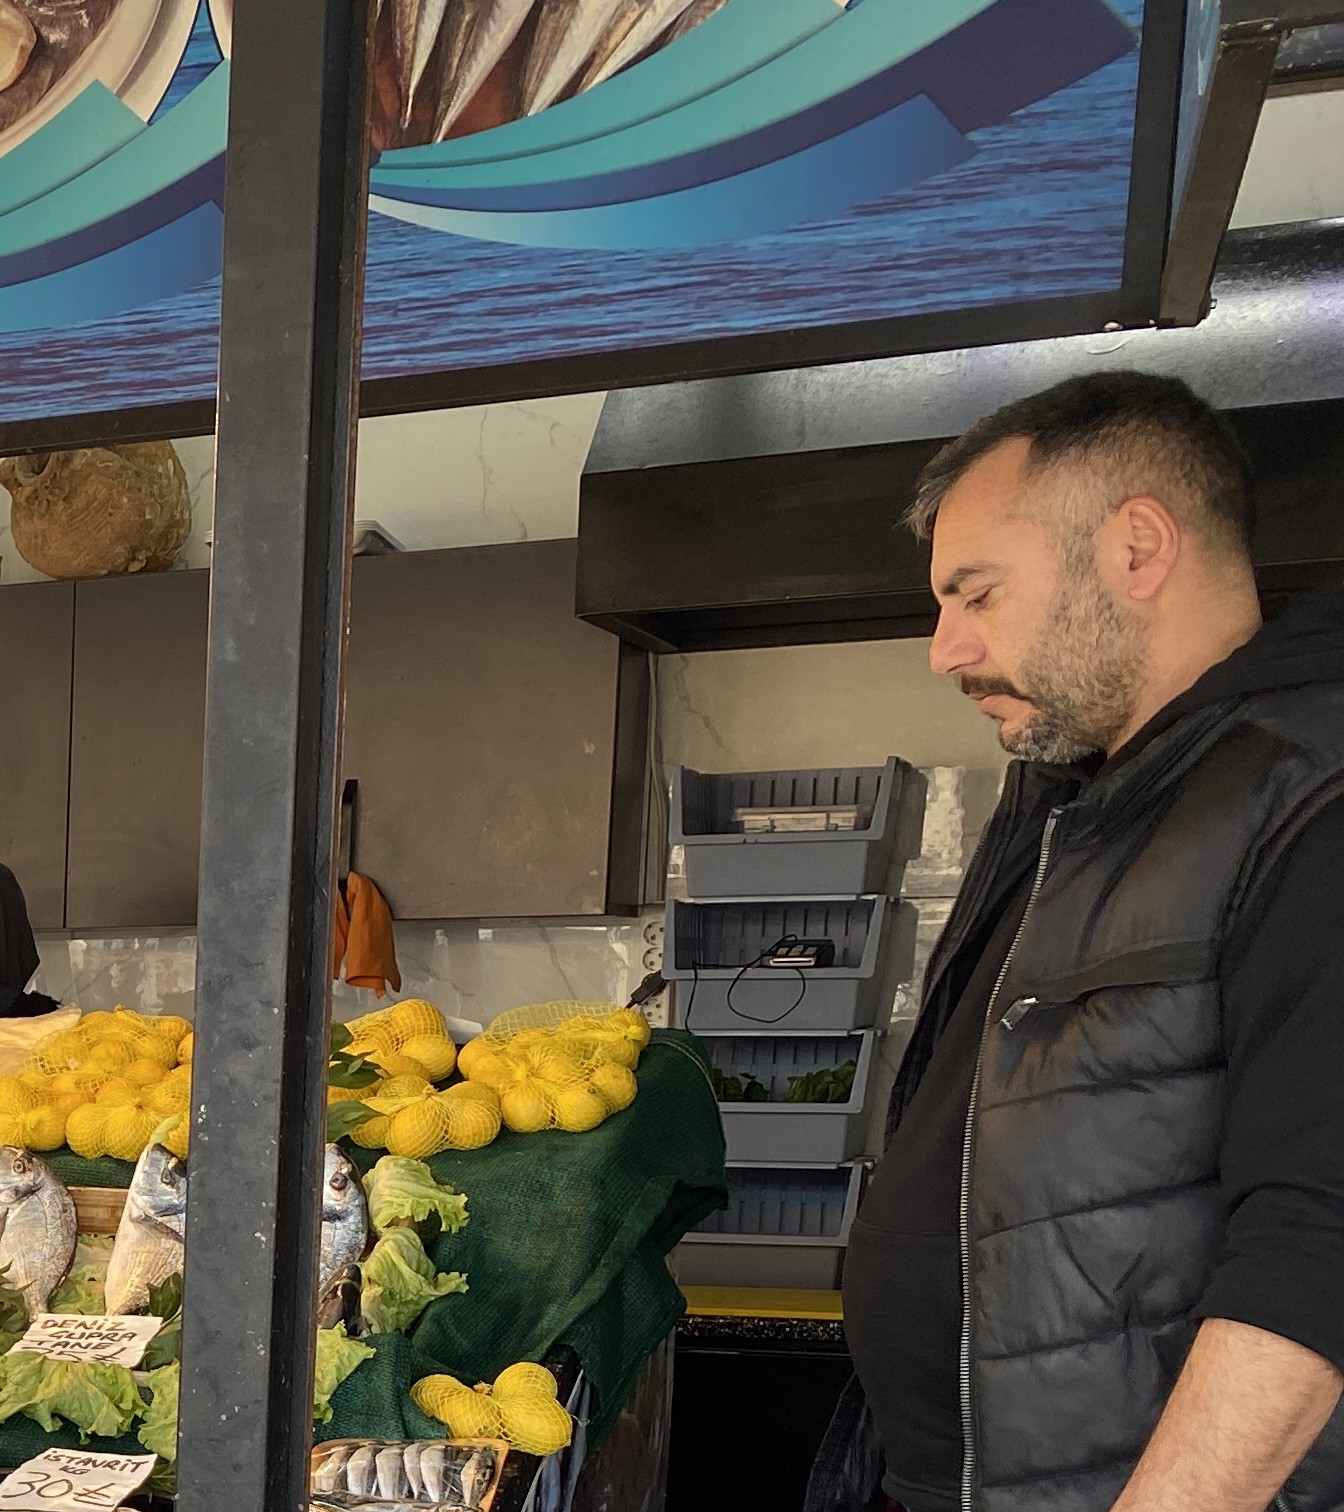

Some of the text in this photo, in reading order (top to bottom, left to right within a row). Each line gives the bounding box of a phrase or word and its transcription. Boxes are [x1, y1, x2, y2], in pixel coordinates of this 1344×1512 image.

[40, 1318, 128, 1332] DENİZ
[29, 1340, 114, 1350] TANE
[43, 1450, 150, 1473] İSTAVRİT
[58, 1465, 92, 1475] KG
